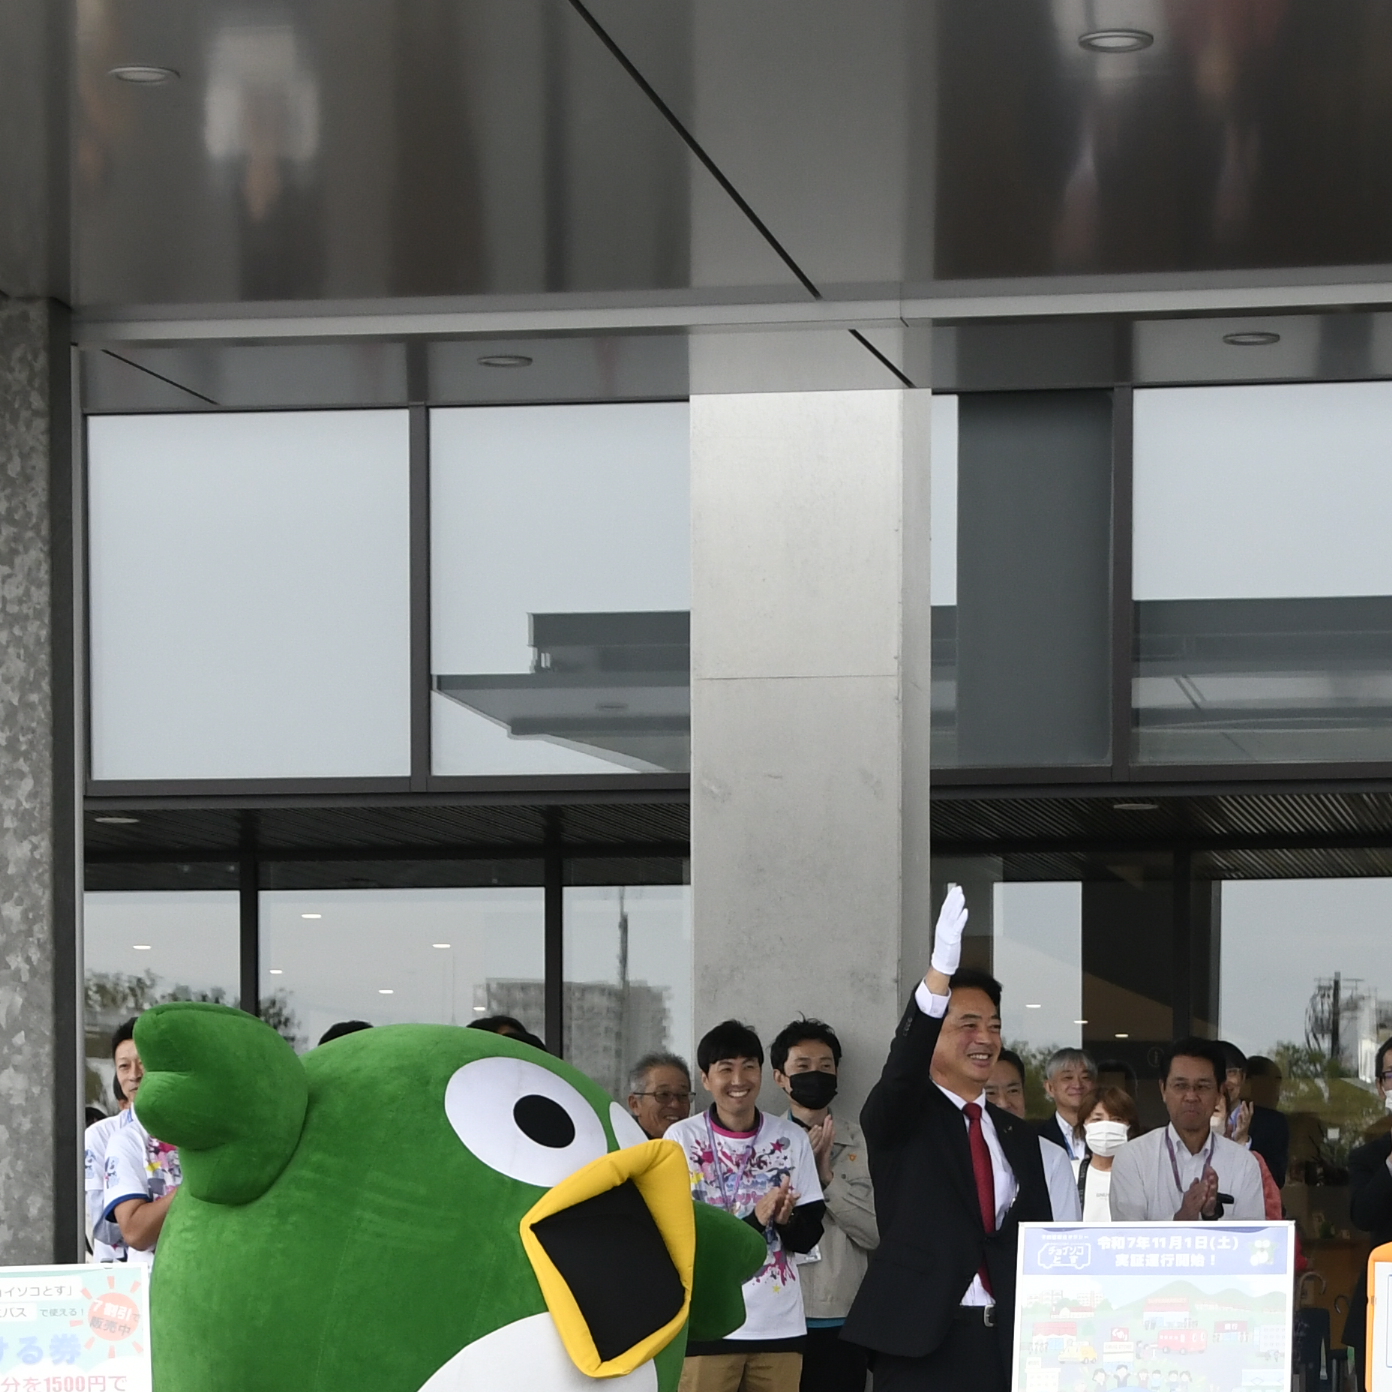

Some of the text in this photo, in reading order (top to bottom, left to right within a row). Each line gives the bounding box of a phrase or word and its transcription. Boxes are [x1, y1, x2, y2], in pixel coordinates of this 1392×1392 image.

[1098, 1235, 1239, 1251] 令和7年11月1日(土)
[1115, 1253, 1216, 1268] 実証運行開始！
[90, 1316, 131, 1336] 販売中
